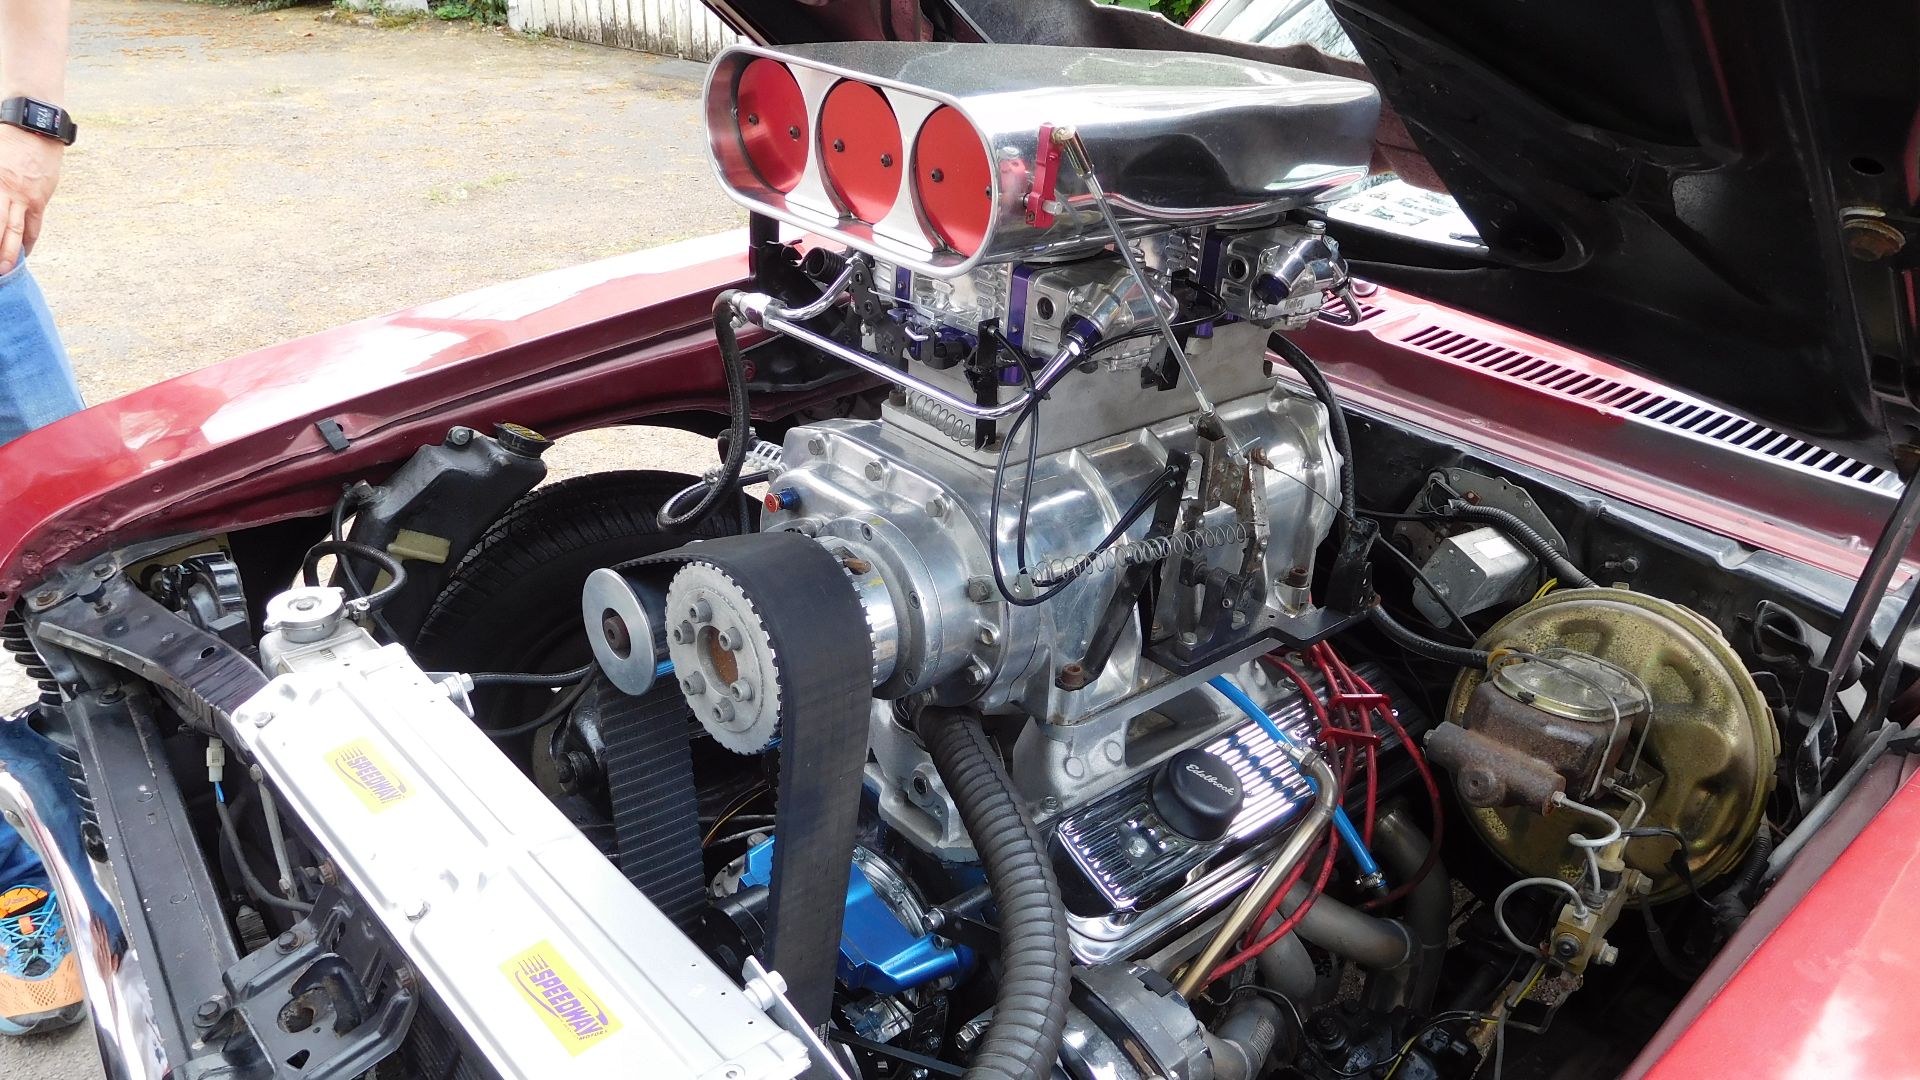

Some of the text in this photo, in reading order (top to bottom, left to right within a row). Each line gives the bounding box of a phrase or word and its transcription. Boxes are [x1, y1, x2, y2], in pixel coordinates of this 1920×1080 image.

[346, 756, 402, 801] SPEEDWAY
[1186, 763, 1235, 796] Edelbrock
[529, 968, 604, 1037] SPEEDWAY
